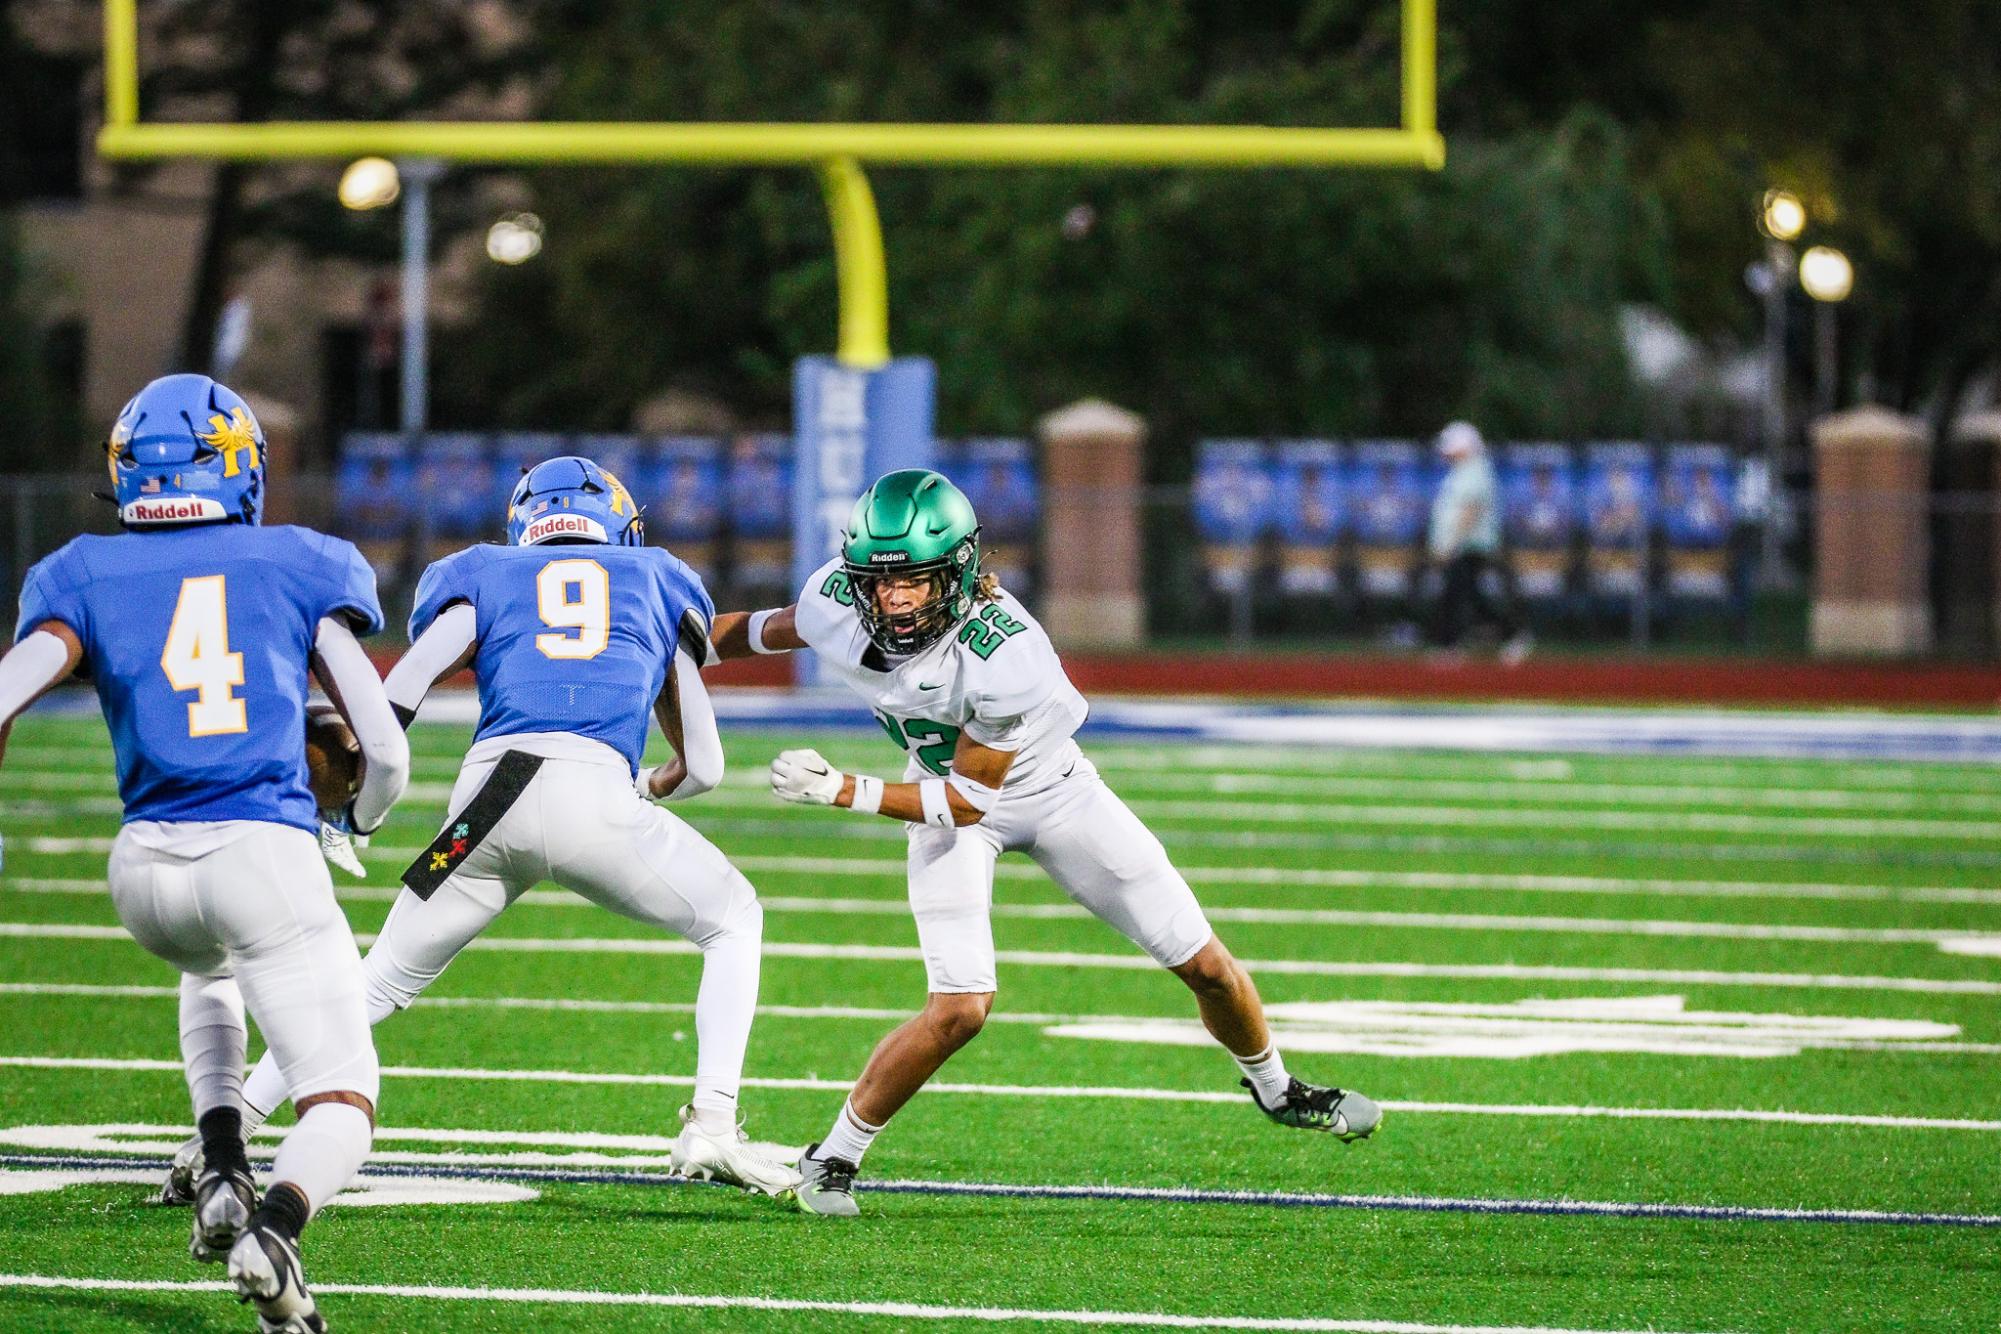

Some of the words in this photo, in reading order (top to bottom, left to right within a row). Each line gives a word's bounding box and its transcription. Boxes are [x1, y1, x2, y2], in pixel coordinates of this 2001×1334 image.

[135, 502, 204, 520] Riddell
[529, 518, 589, 541] Riddell
[871, 552, 906, 562] Riddell
[535, 558, 610, 660] 9
[958, 603, 1028, 662] 22
[160, 574, 248, 738] 4
